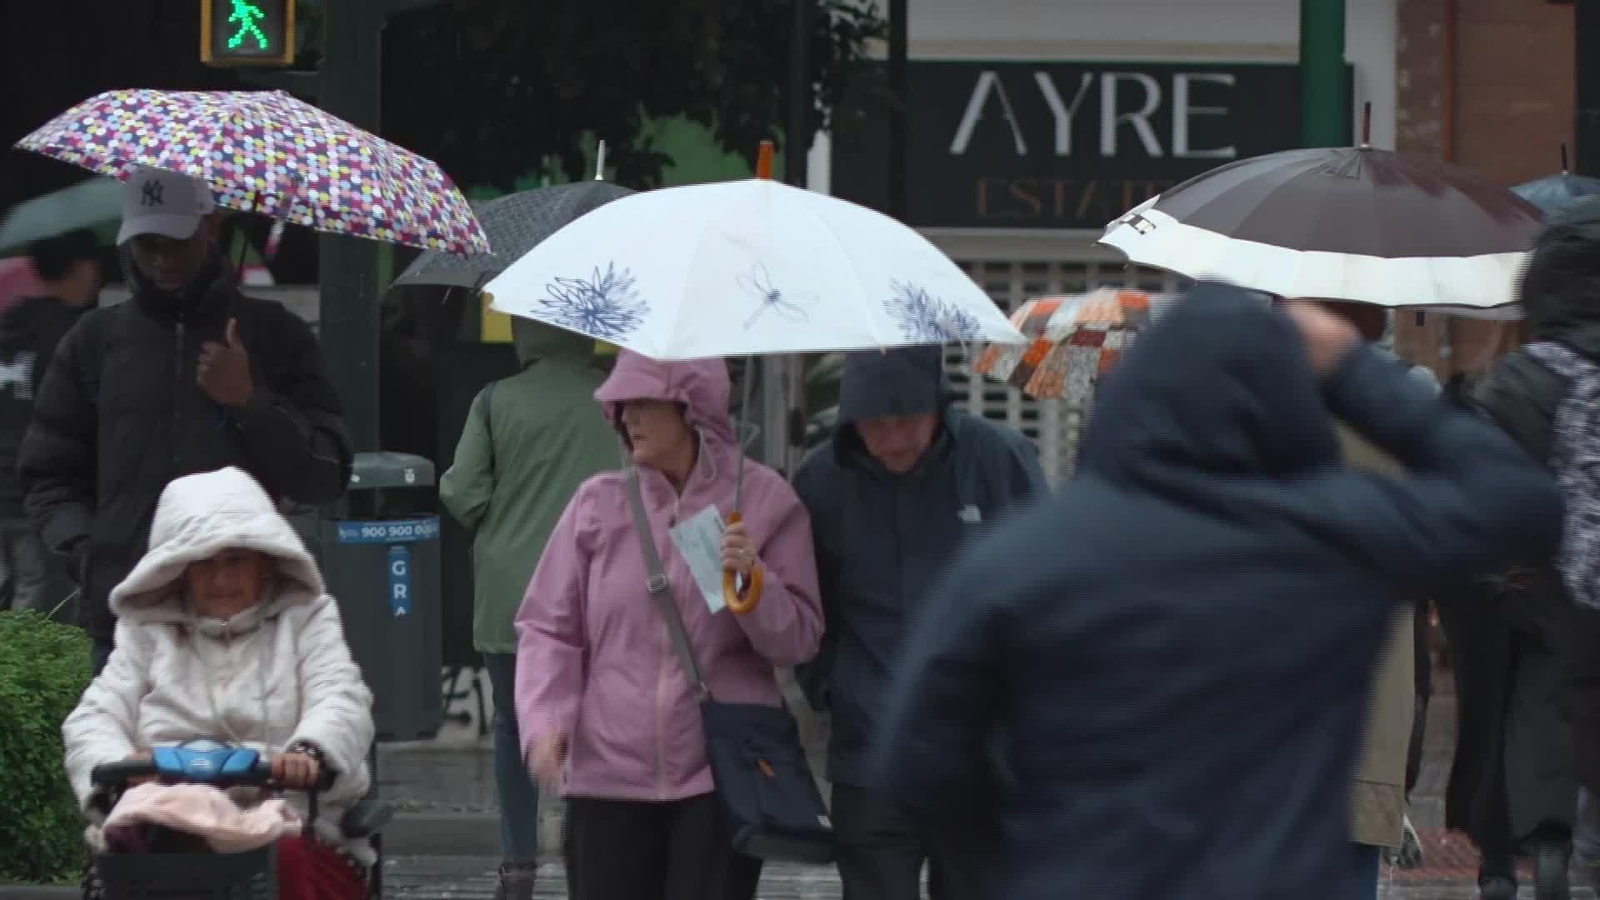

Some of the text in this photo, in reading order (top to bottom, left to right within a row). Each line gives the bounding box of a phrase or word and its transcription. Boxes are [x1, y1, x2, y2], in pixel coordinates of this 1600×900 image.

[949, 71, 1236, 157] AYRE
[362, 526, 386, 537] 900
[389, 525, 412, 536] 900
